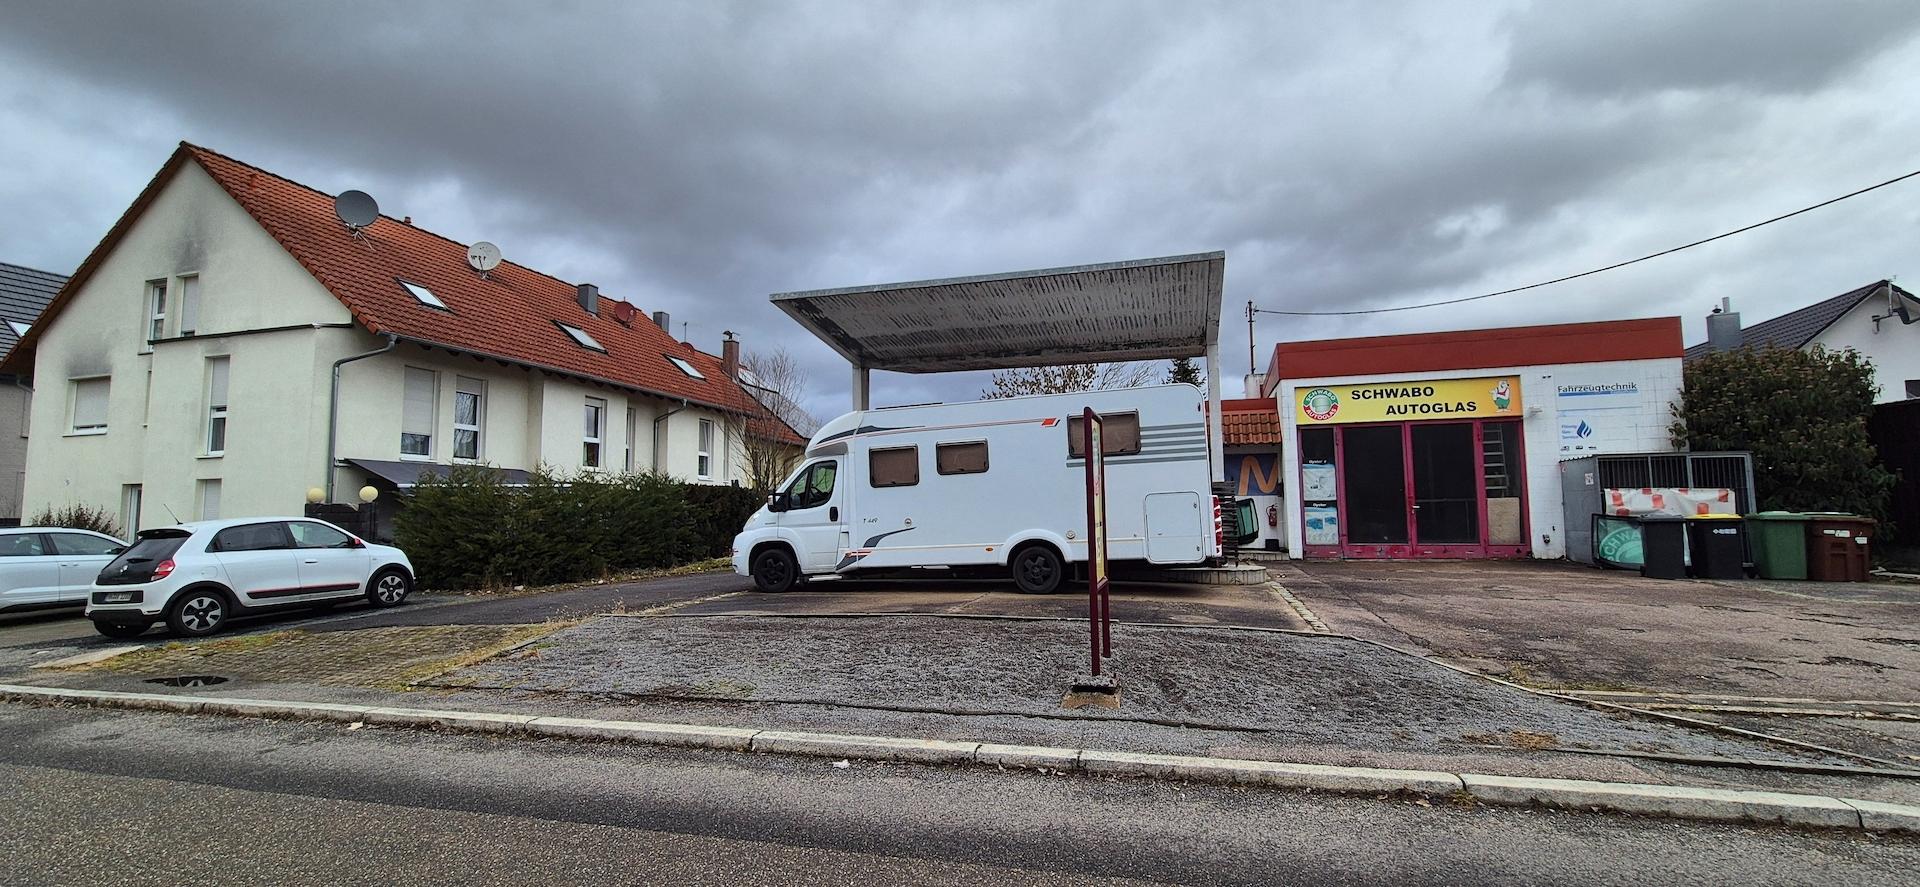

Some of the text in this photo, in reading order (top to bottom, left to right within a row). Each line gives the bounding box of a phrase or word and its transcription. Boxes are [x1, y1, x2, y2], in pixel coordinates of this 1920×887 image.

[1351, 386, 1435, 400] SCHWABO
[1557, 382, 1637, 393] Fahrzeugtechnik
[1305, 390, 1336, 402] SCHWABO
[1306, 407, 1337, 419] AUTOGLAS
[1386, 401, 1477, 415] AUTOGLAS
